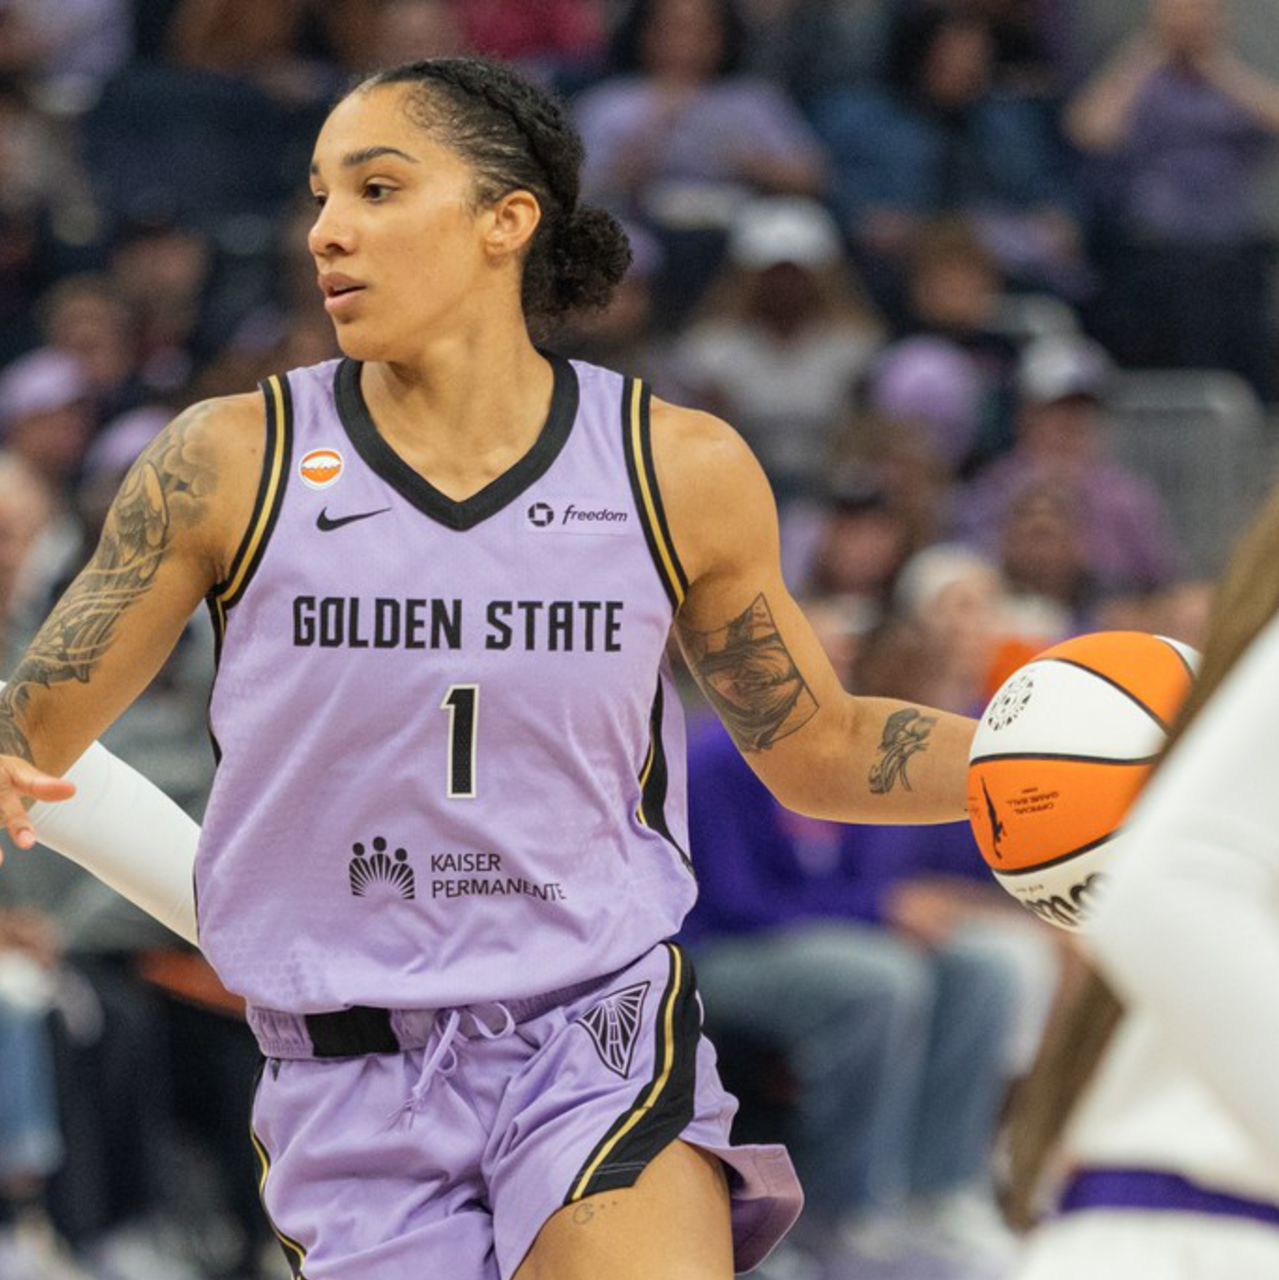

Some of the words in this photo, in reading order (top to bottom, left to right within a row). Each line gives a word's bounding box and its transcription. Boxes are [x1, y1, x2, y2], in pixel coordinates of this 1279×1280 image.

[563, 504, 629, 525] freedom
[293, 596, 462, 650] GOLDEN
[485, 600, 625, 652] STATE
[440, 684, 480, 799] 1
[431, 853, 501, 872] KAISER
[431, 879, 567, 901] PERMANENTE
